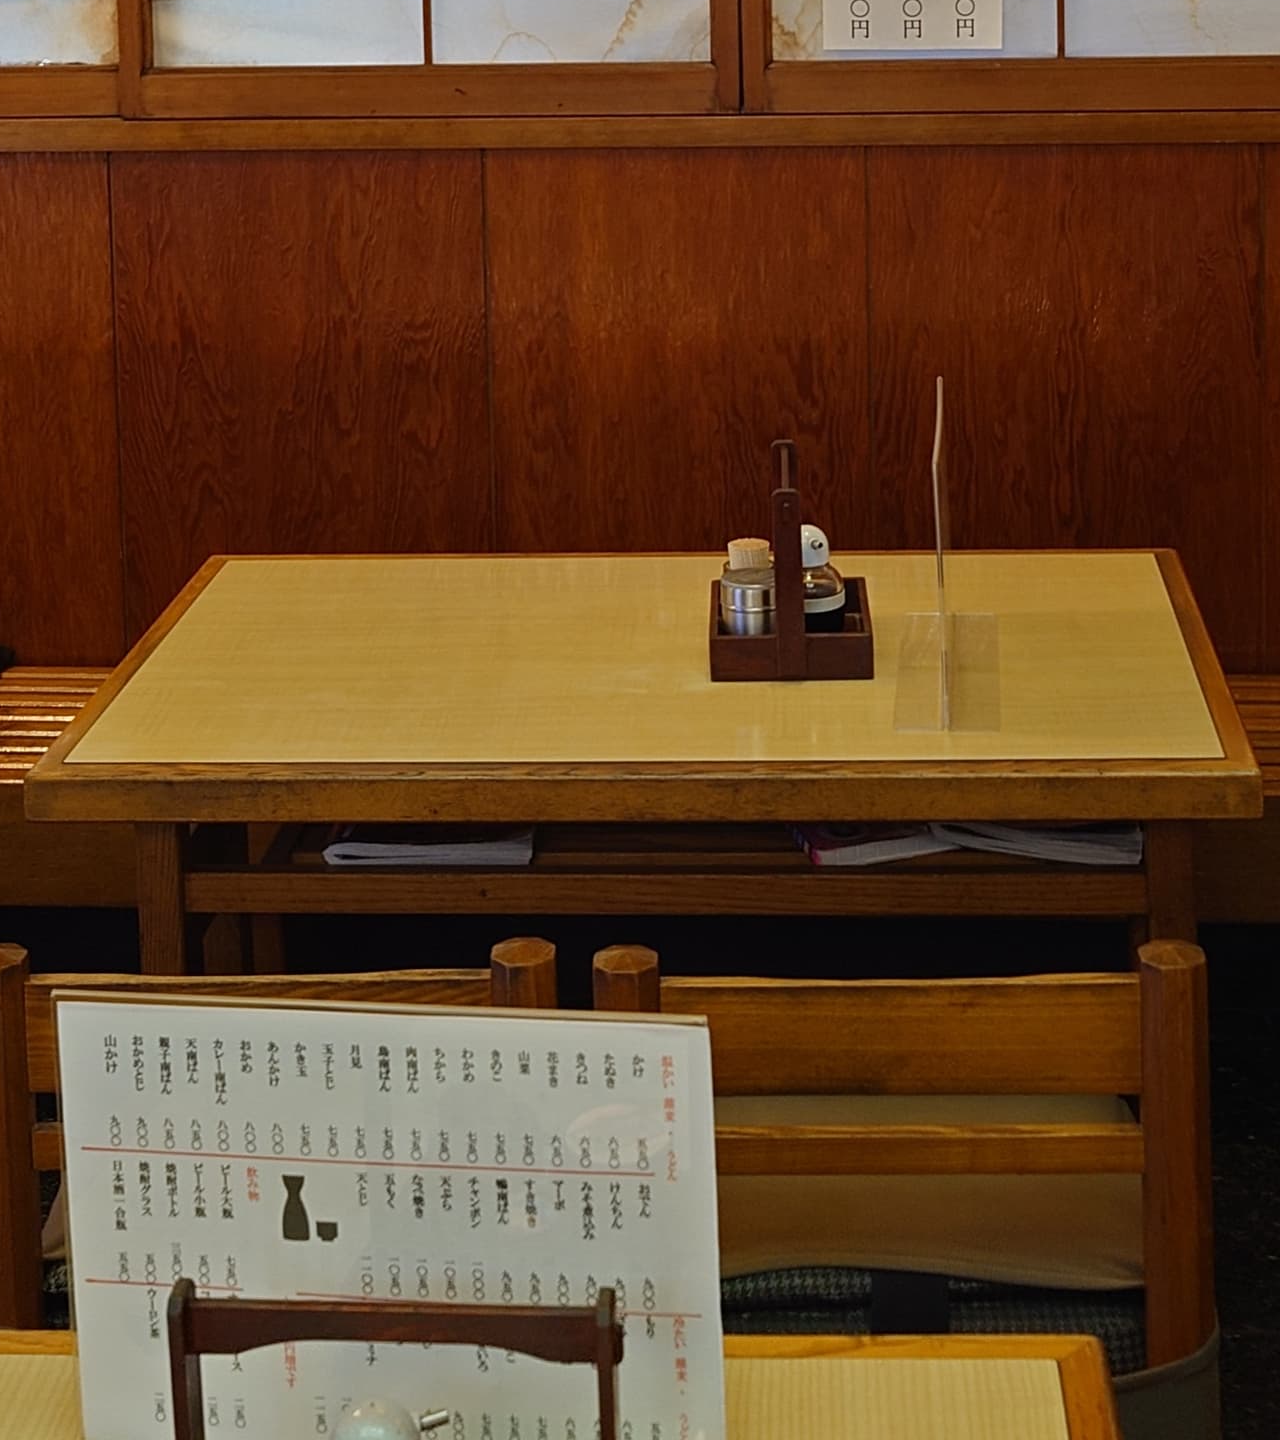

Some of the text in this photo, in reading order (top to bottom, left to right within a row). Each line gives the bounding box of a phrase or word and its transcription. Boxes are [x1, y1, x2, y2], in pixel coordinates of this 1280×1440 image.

[103, 1034, 119, 1074] 山かけ
[239, 1039, 253, 1074] おかめ
[267, 1040, 281, 1088] あんかけ
[433, 1047, 447, 1084] ちから
[461, 1047, 476, 1084] わかめ
[575, 1052, 589, 1086] きつね
[603, 1053, 617, 1090] たぬき
[631, 1054, 645, 1078] かけ
